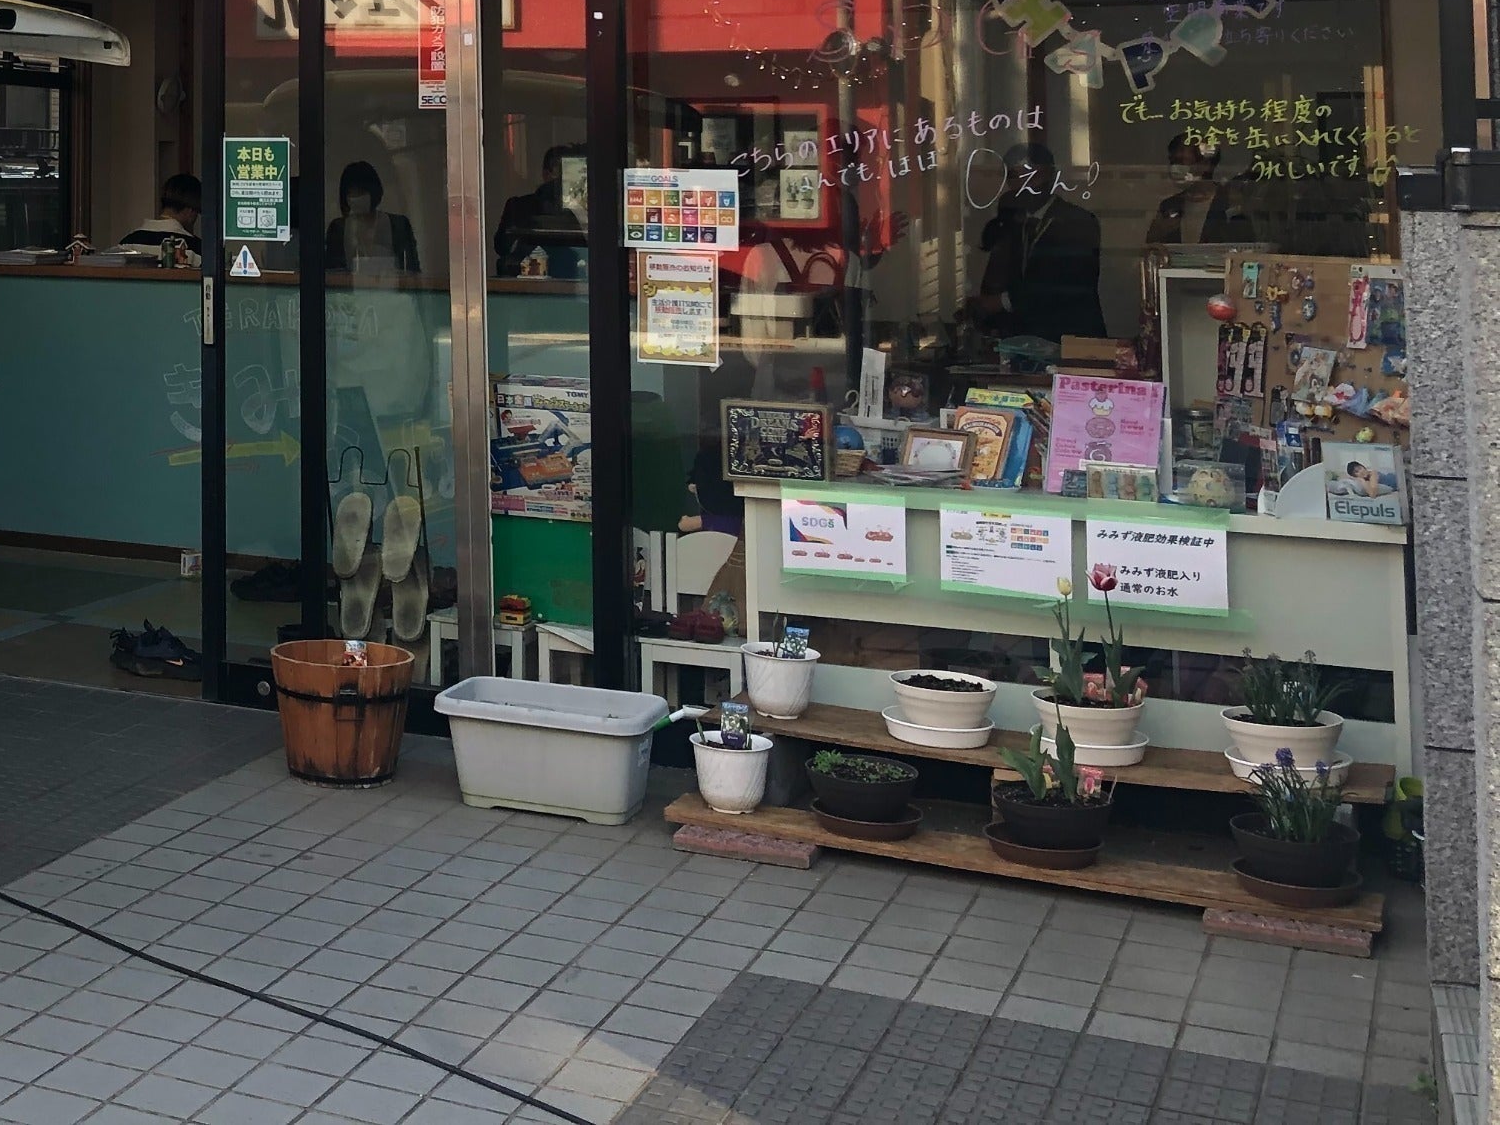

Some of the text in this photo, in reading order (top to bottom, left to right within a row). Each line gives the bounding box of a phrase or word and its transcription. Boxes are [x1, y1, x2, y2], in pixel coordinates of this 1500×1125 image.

[430, 5, 446, 72] 防犯カメラ設置
[421, 95, 447, 105] SECO
[237, 146, 275, 162] 本日も
[236, 164, 278, 180] 営業中
[651, 175, 679, 183] GOALS
[566, 391, 589, 399] TOMY
[1335, 500, 1396, 519] Elepuls
[1097, 529, 1215, 548] みみず液肥効果検証中
[1120, 565, 1201, 582] みみず液肥入り
[1119, 582, 1179, 598] 通常のお水
